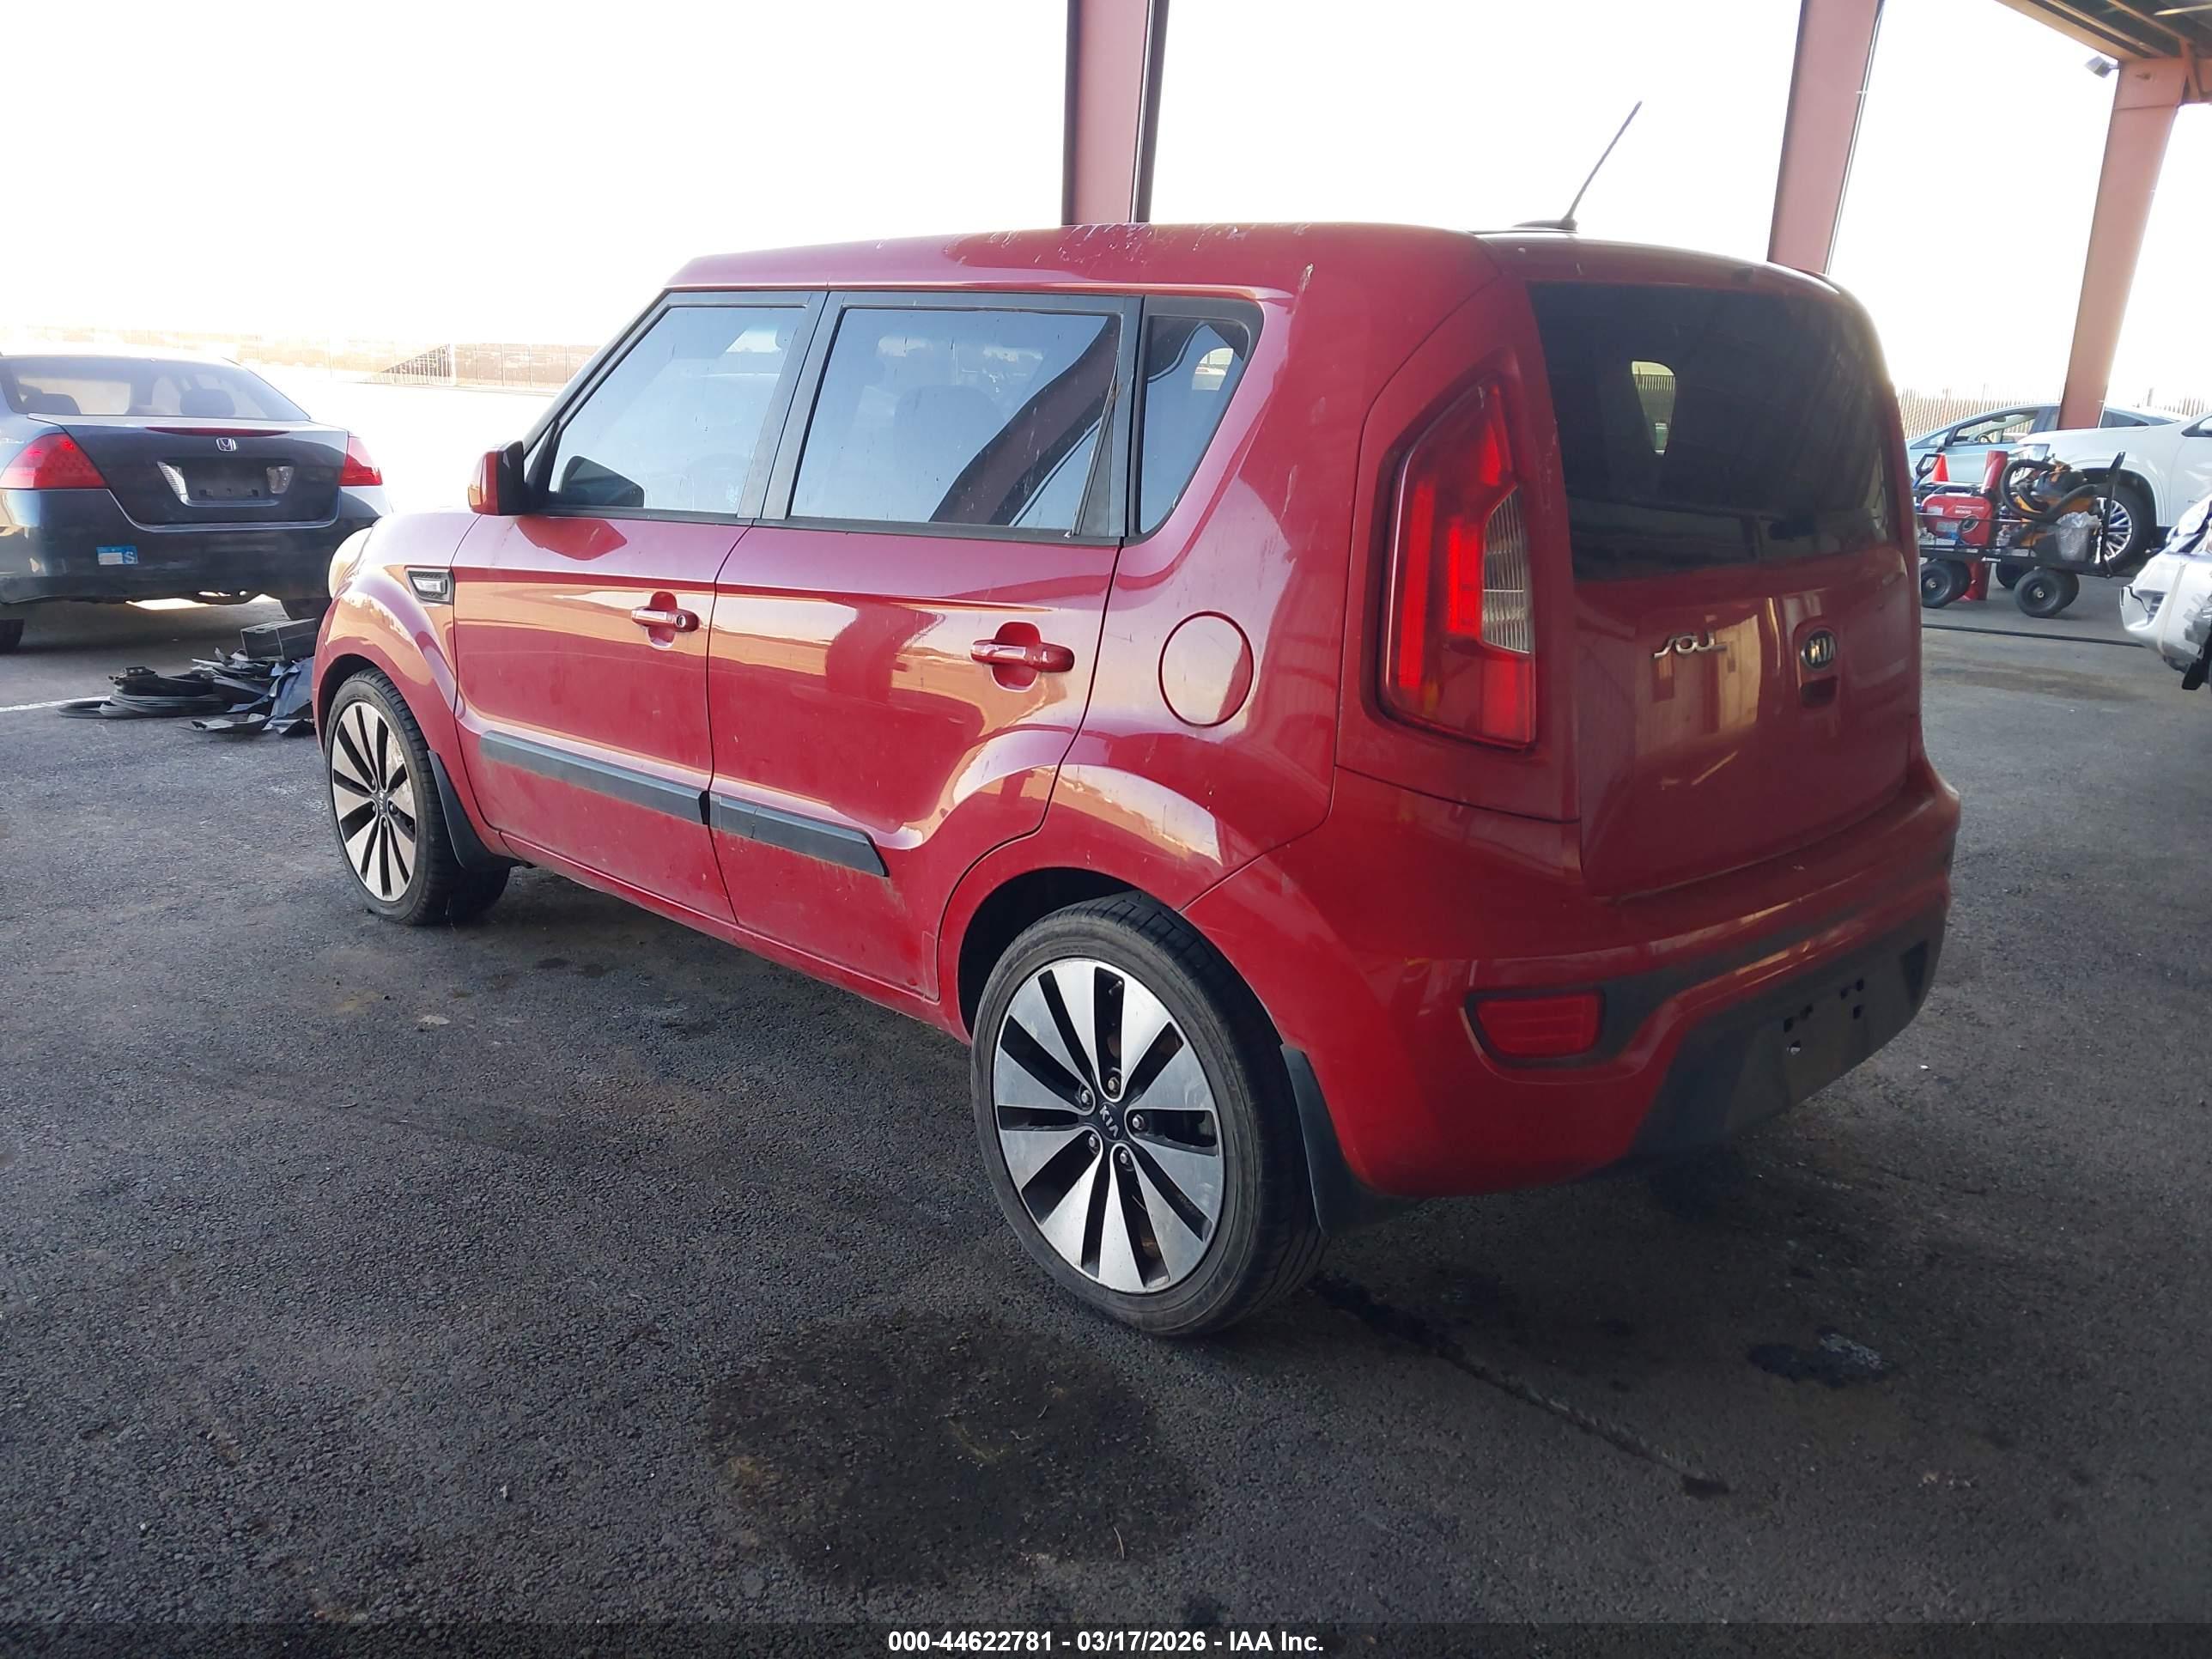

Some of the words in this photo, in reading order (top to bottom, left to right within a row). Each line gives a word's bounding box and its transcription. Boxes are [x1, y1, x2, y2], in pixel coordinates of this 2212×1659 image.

[1653, 631, 1727, 659] SOUL
[1810, 636, 1836, 664] KIA
[1099, 1104, 1119, 1138] KIA
